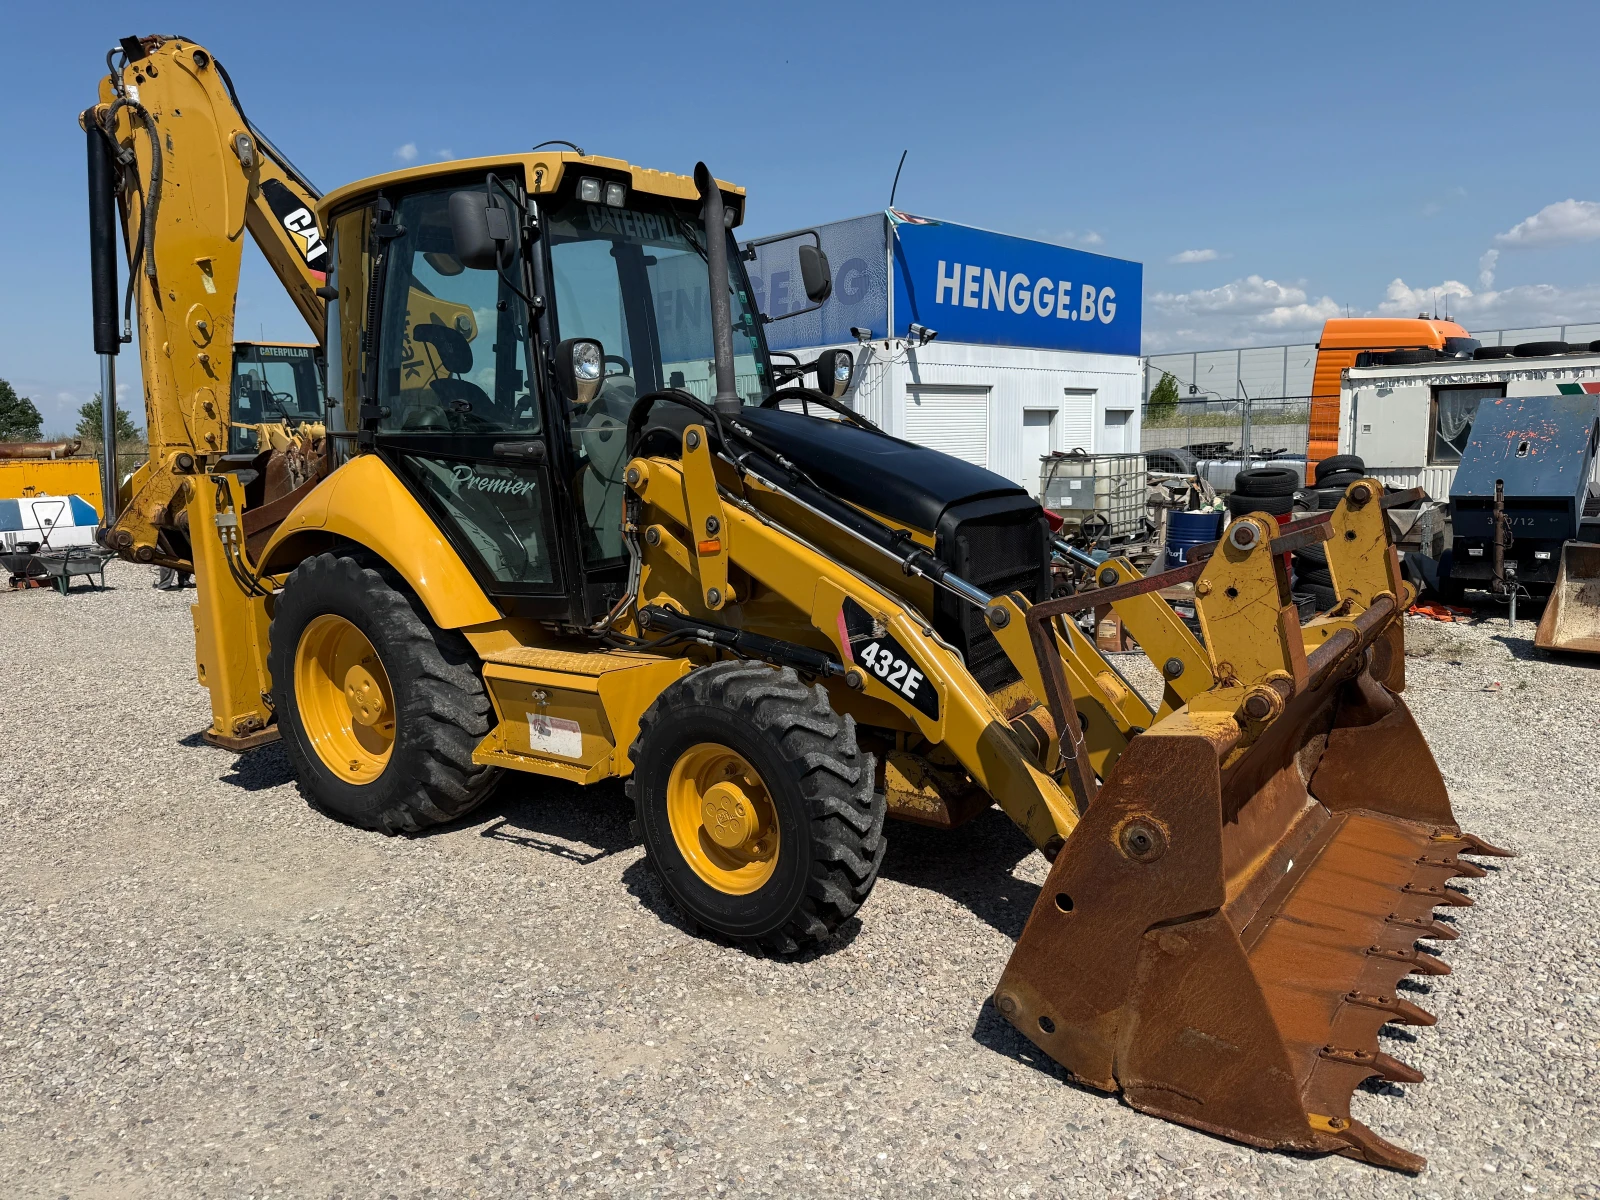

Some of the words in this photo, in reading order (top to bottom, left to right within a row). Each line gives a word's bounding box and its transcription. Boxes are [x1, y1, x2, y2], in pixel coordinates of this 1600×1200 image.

[283, 207, 328, 263] CAT
[586, 204, 700, 244] CATERPILL
[935, 259, 1117, 325] HENGGE.BG
[259, 346, 309, 358] CATERPILLAR
[449, 465, 536, 496] Premier
[860, 641, 924, 700] 432E
